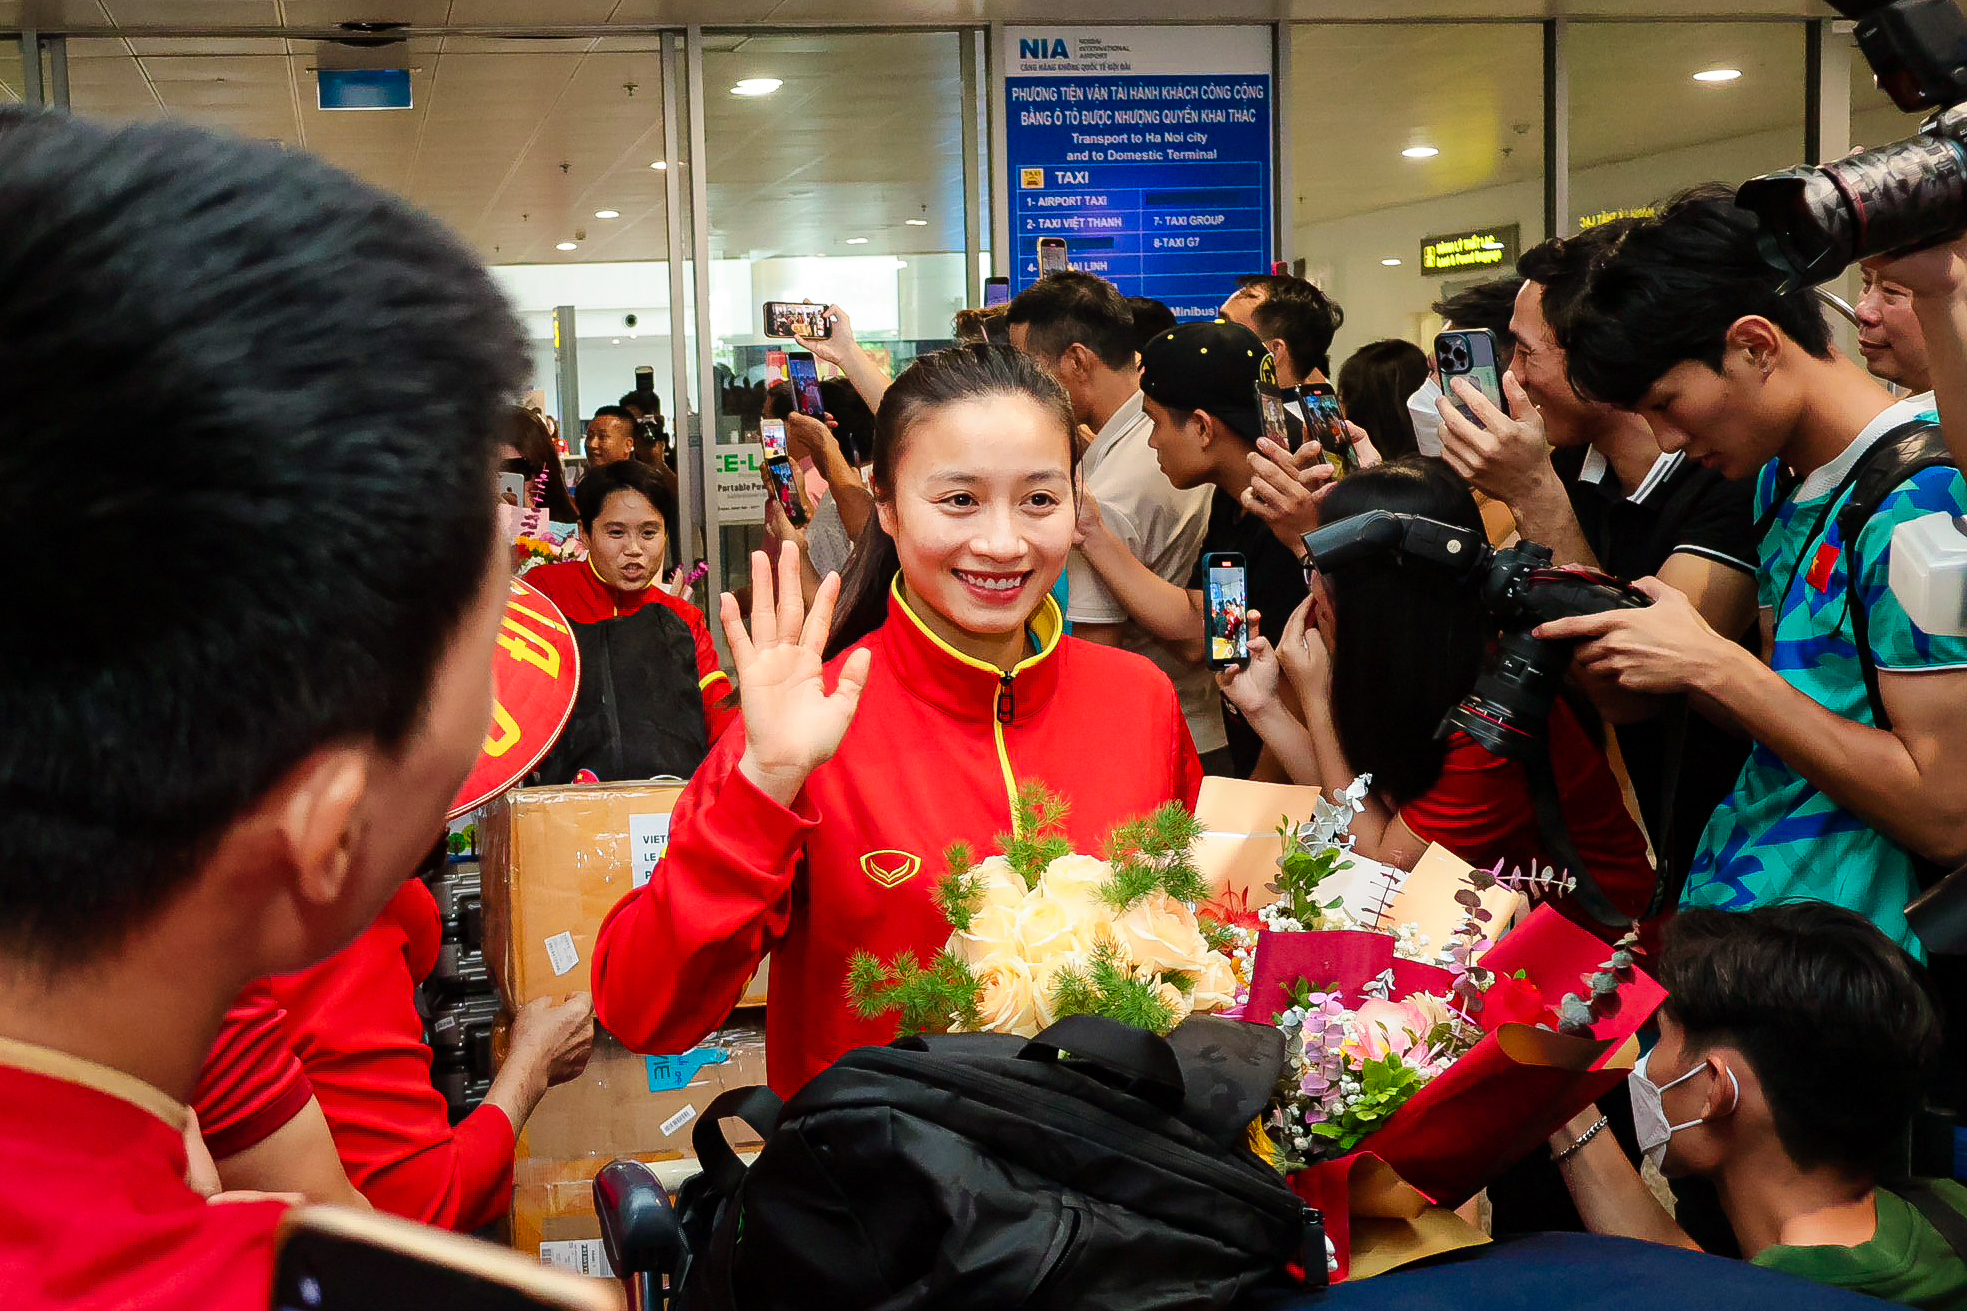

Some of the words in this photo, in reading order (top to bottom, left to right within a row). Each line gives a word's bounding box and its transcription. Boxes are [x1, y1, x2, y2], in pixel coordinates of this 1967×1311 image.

[1019, 38, 1069, 59] NIA
[1012, 86, 1057, 101] PHƯƠNG
[1060, 84, 1084, 104] TIỆN
[1086, 83, 1108, 104] VẬN
[1130, 82, 1159, 100] HÀNH
[1162, 82, 1199, 100] KHÁCH
[1201, 82, 1231, 99] CÔNG
[1234, 82, 1264, 102] CỘNG
[1065, 107, 1080, 125] TÔ
[1082, 109, 1112, 128] ĐƯỢC
[1114, 109, 1160, 128] NHƯỢNG
[1162, 104, 1199, 124] QUYỀN
[1201, 109, 1226, 123] KHAI
[1228, 105, 1256, 123] THÁC
[1072, 132, 1128, 146] Transport
[1131, 133, 1143, 144] to
[1146, 132, 1162, 143] Ha
[1164, 131, 1184, 142] Noi
[1186, 132, 1208, 145] city
[1067, 150, 1089, 161] and
[1091, 150, 1104, 161] to
[1107, 149, 1163, 160] Domestic
[1167, 148, 1217, 160] Terminal
[1055, 171, 1089, 184] TAXI
[1027, 197, 1036, 206] 1-
[1038, 196, 1082, 206] AIRPORT
[1084, 195, 1108, 206] TAXI
[1027, 219, 1036, 229] 2-
[1038, 218, 1061, 229] TAXI
[1063, 216, 1085, 230] VIỆT
[1087, 216, 1122, 228] THANH
[1165, 216, 1188, 226] TAXI
[1189, 215, 1225, 225] GROUP
[1187, 236, 1200, 247] G7
[1085, 261, 1108, 271] LINH
[717, 483, 751, 492] Portable
[642, 835, 670, 844] VIET
[644, 852, 657, 862] LE
